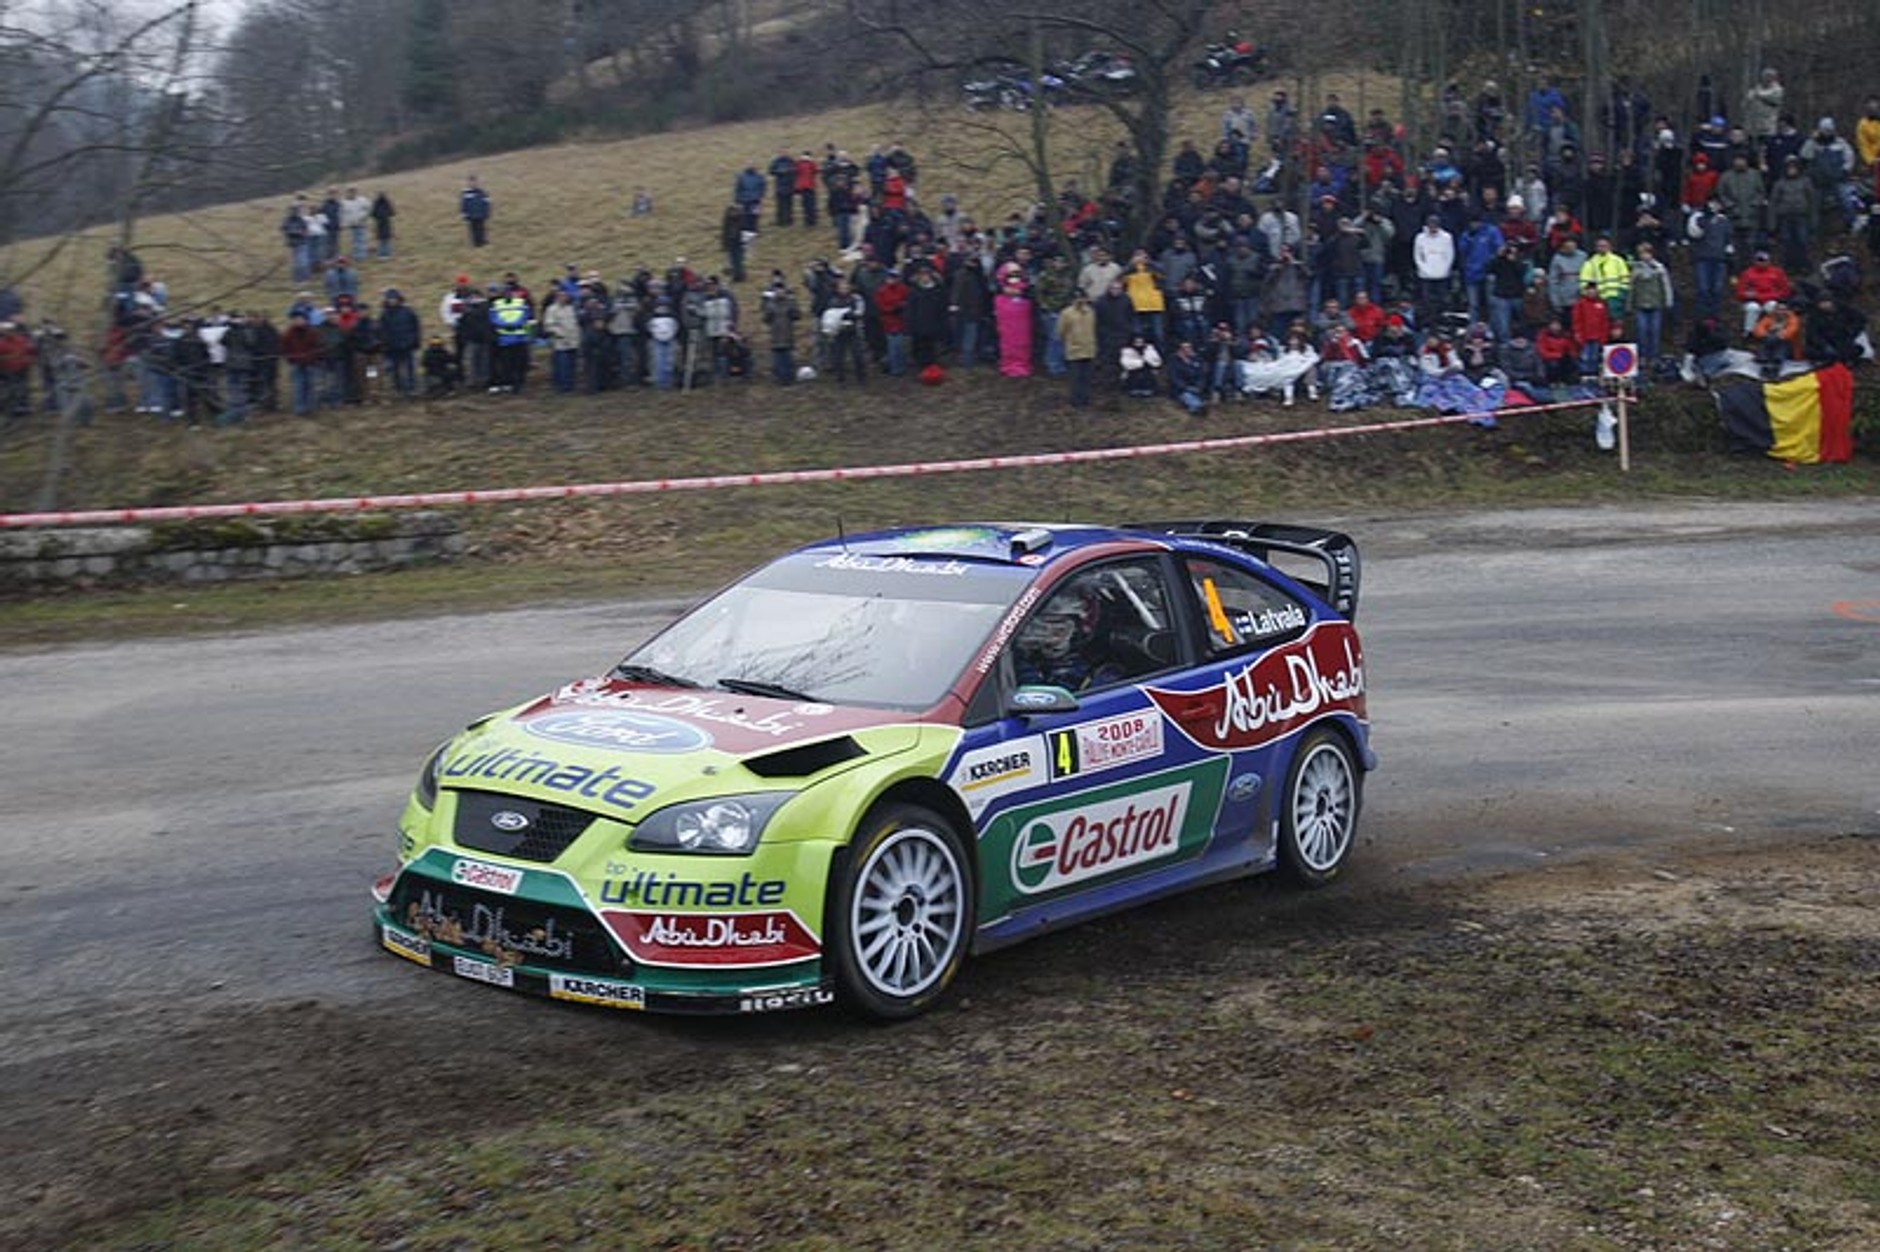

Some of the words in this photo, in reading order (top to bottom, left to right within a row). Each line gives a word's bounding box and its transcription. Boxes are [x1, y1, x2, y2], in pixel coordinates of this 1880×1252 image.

[1203, 577, 1235, 645] 4
[1249, 604, 1306, 635] Latvala
[1215, 664, 1291, 740] Abu
[1285, 638, 1365, 714] Dhabi
[549, 715, 680, 747] Ford
[1097, 718, 1144, 741] 2008
[1056, 732, 1071, 775] 4
[444, 750, 657, 809] ultimate
[1057, 793, 1179, 875] Castrol
[600, 870, 786, 906] ultimate
[639, 916, 704, 946] Abu
[703, 917, 787, 946] Dhabi
